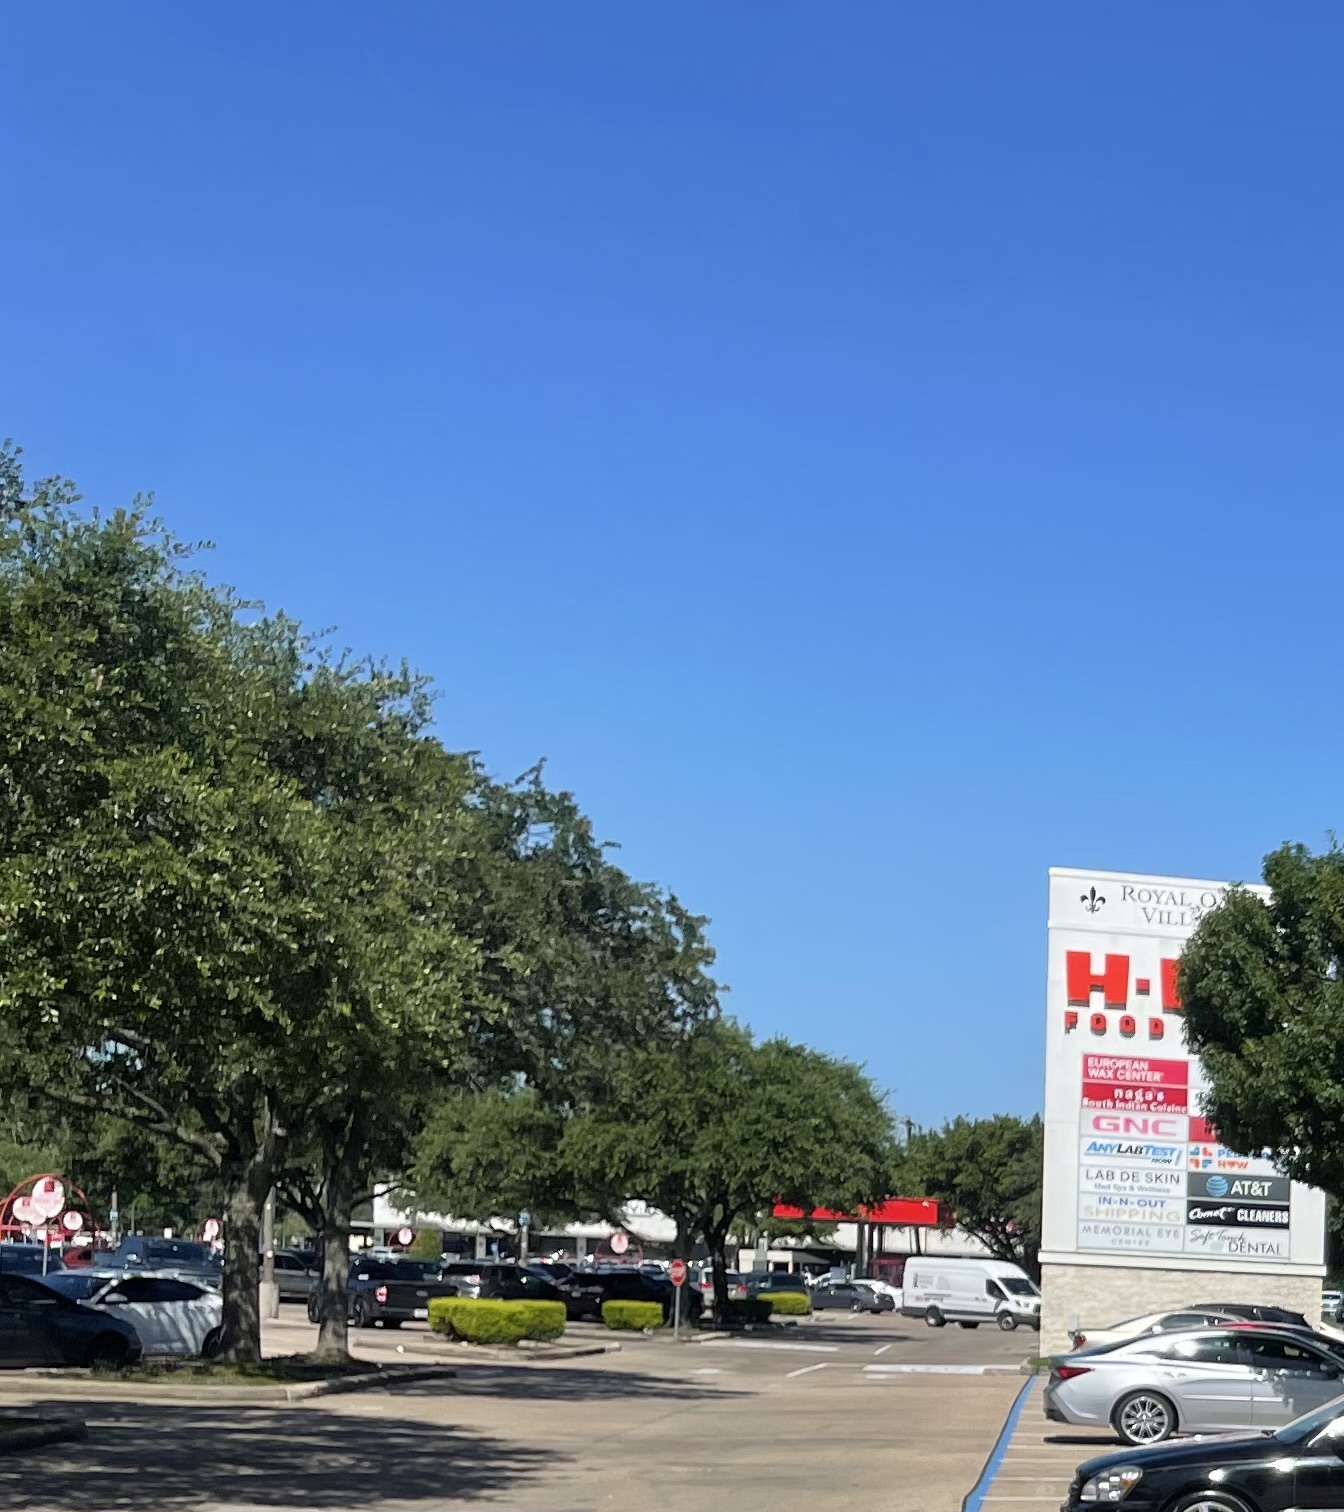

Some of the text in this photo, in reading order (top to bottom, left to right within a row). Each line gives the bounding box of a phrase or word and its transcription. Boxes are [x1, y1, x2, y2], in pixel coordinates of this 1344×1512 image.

[1121, 885, 1192, 907] ROYAL
[1141, 907, 1199, 927] VILL
[1065, 1012, 1164, 1038] FOOD
[1087, 1056, 1149, 1071] EUROPEAN
[1087, 1068, 1161, 1082] WAX CENTER
[1092, 1115, 1176, 1136] GNC
[1085, 1169, 1180, 1184] LAB DE SKIN
[1230, 1180, 1272, 1196] AT&T
[1098, 1196, 1166, 1208] IN-N-OUT
[1083, 1205, 1181, 1222] SHIPPING
[1237, 1209, 1288, 1223] CLEANERS
[1082, 1225, 1179, 1239] MEMORIAL EYE
[1228, 1241, 1283, 1255] DENTAL
